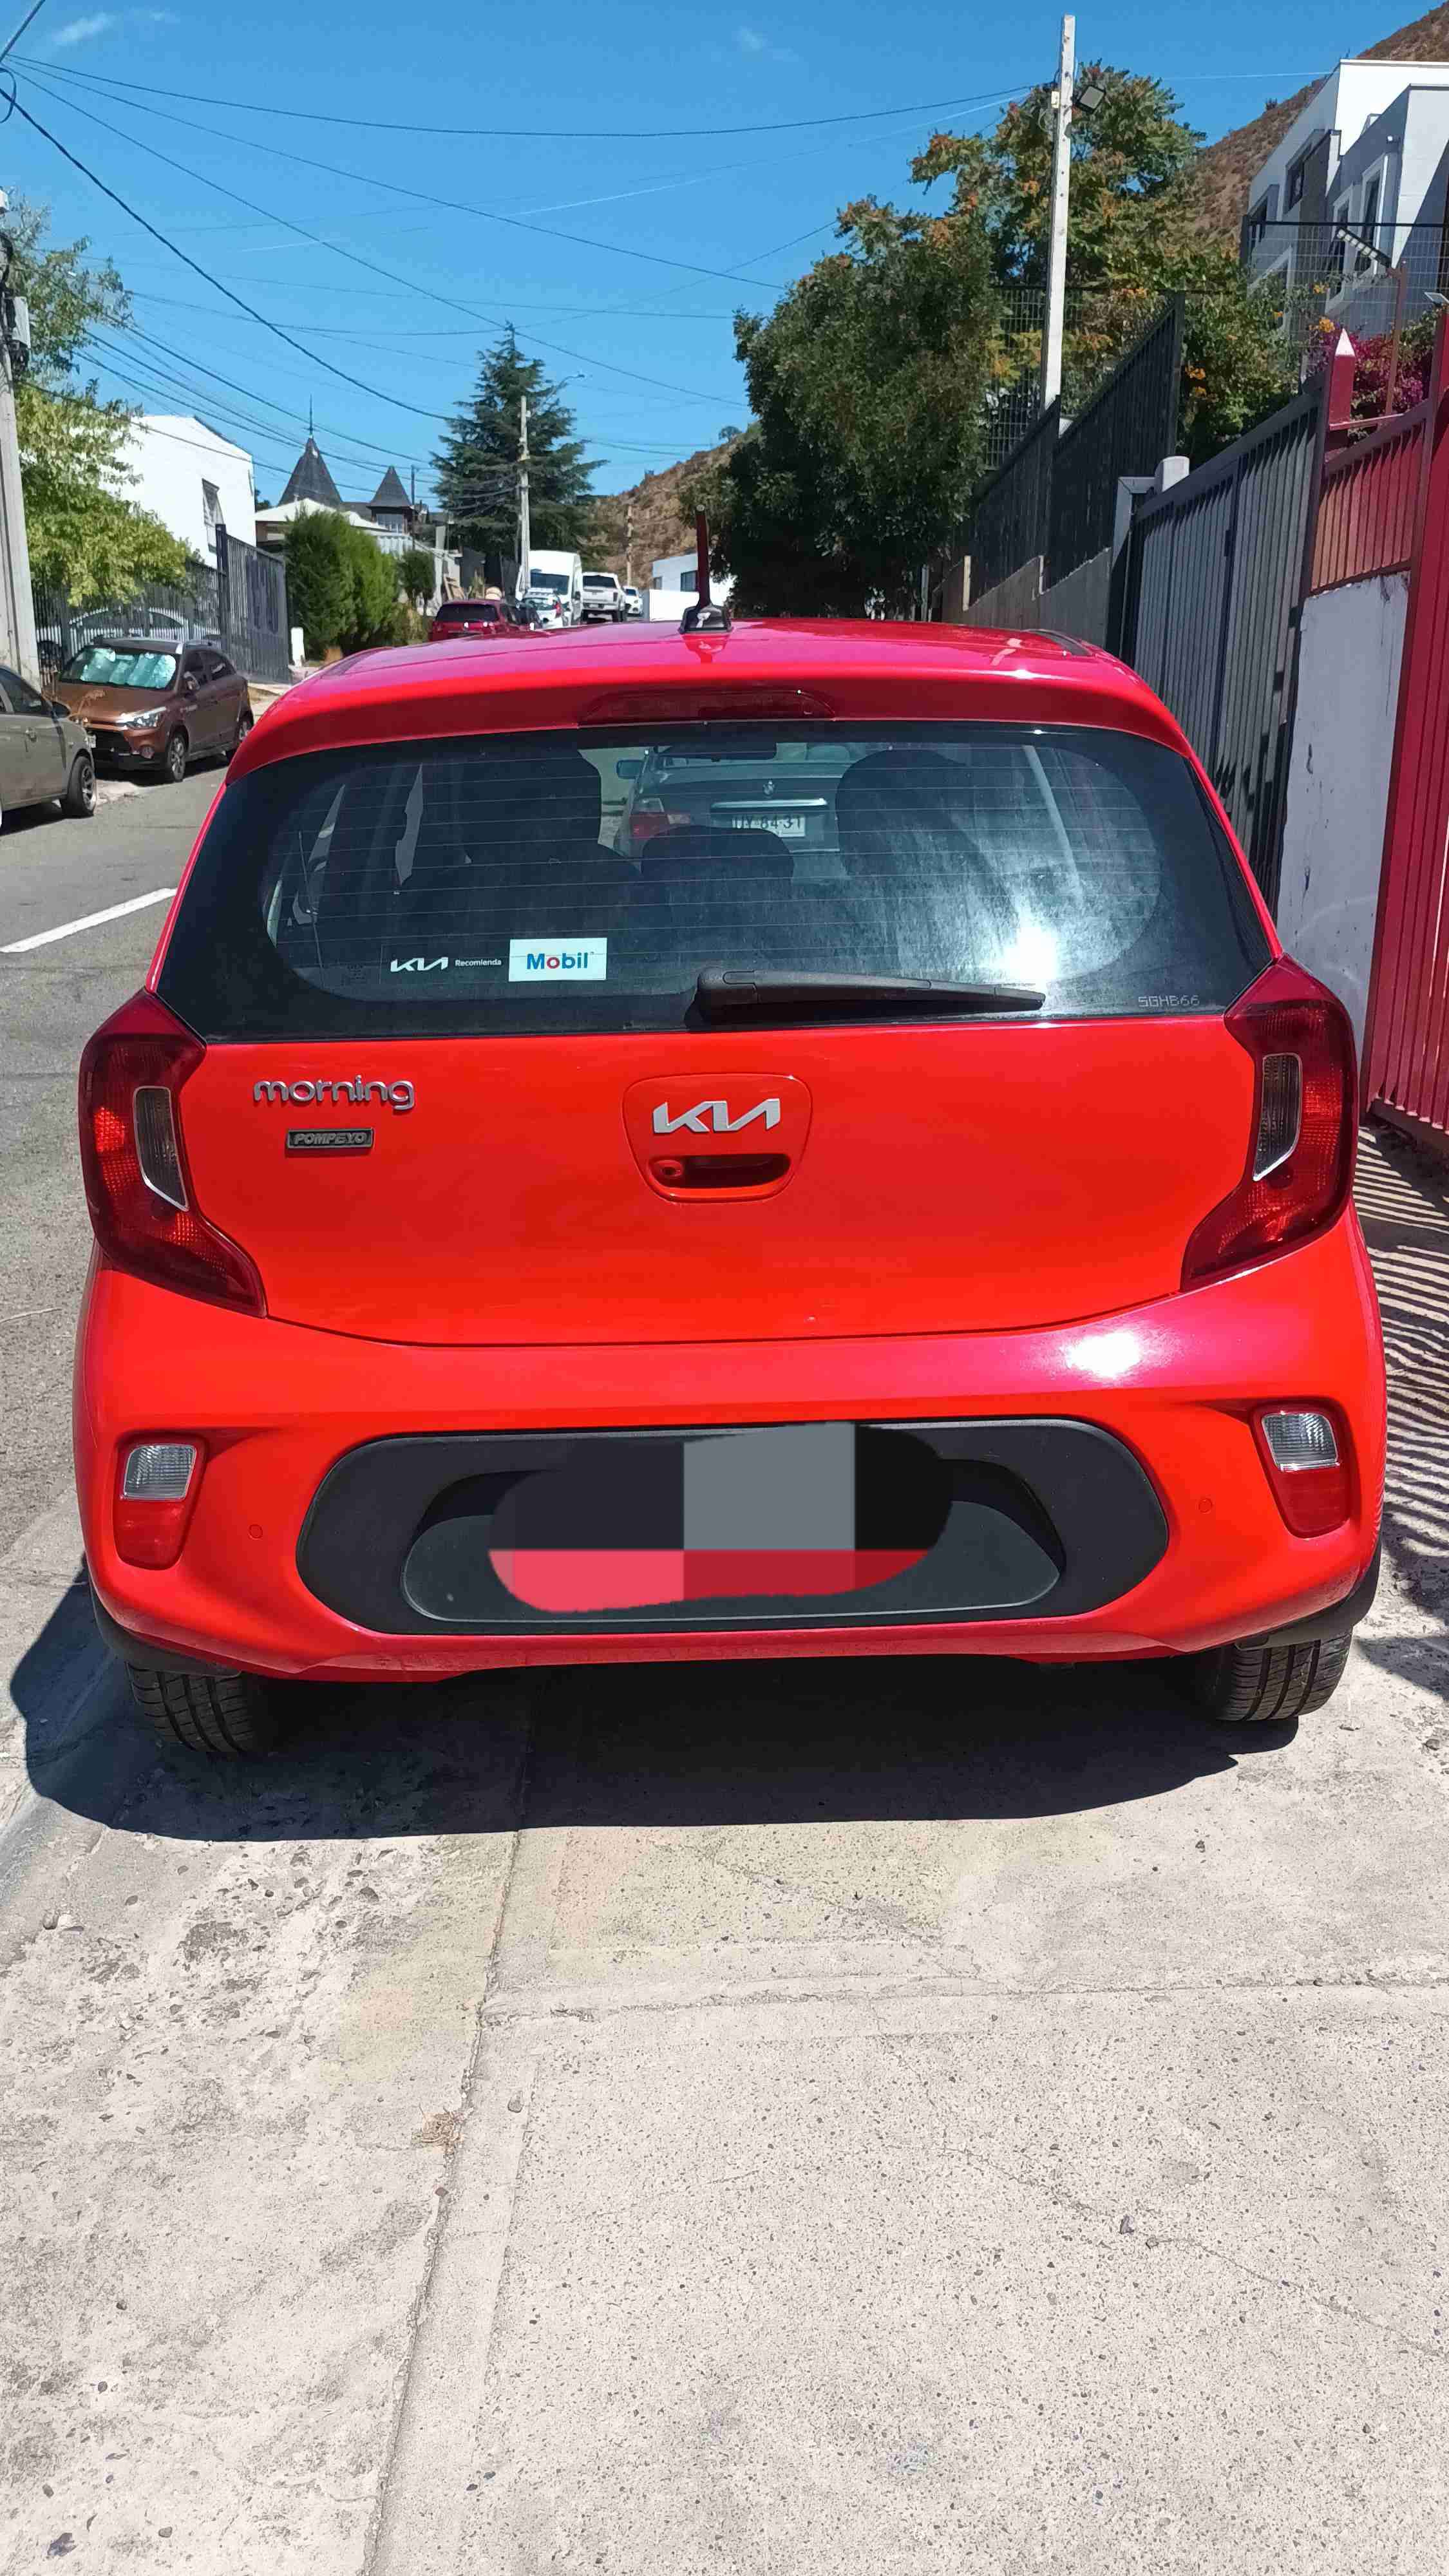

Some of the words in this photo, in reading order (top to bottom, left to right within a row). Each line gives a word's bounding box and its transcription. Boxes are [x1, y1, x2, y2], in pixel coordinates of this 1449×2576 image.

[390, 957, 449, 972] KIA
[455, 958, 502, 967] Recomienda
[527, 952, 589, 970] Mobil
[254, 1075, 415, 1110] morning
[653, 1098, 780, 1133] KIA
[294, 1132, 366, 1144] POMPEYO
